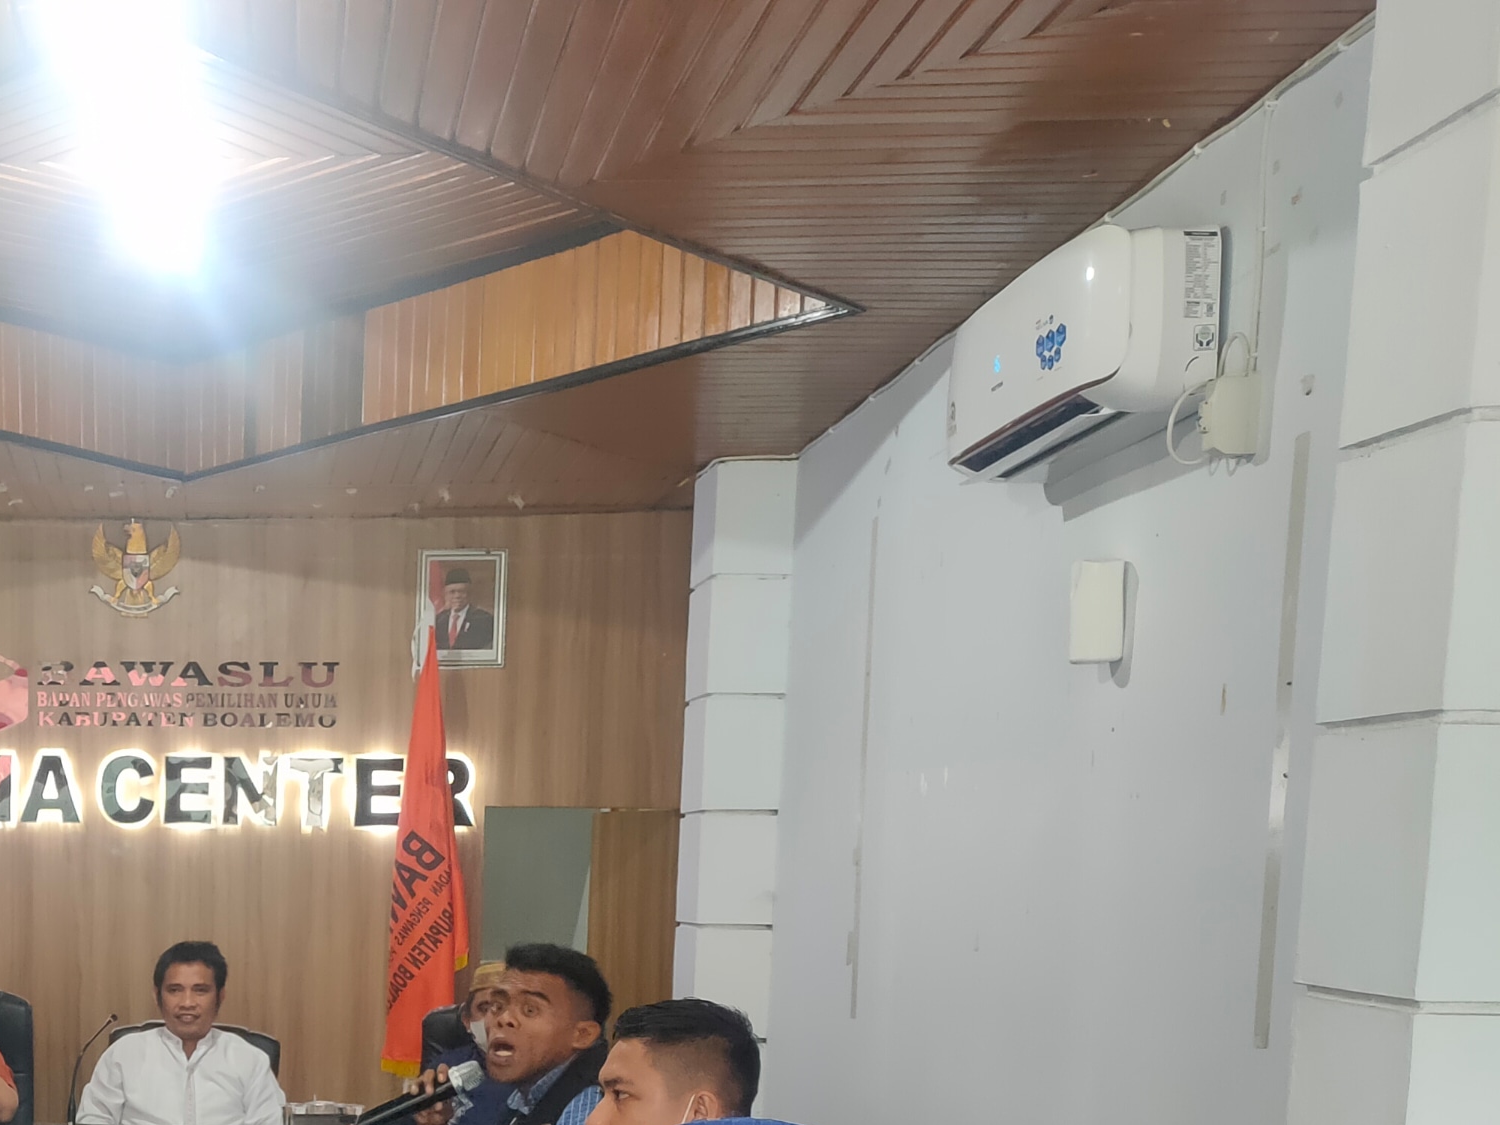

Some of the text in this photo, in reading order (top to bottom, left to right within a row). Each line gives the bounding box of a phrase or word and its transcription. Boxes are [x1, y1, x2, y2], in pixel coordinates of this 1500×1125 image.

[37, 660, 340, 688] BAWASLU
[37, 691, 339, 708] BADAN PENGAWAS PEMILIHAN UMUM
[37, 712, 338, 729] KABUPATEN BOALEMO
